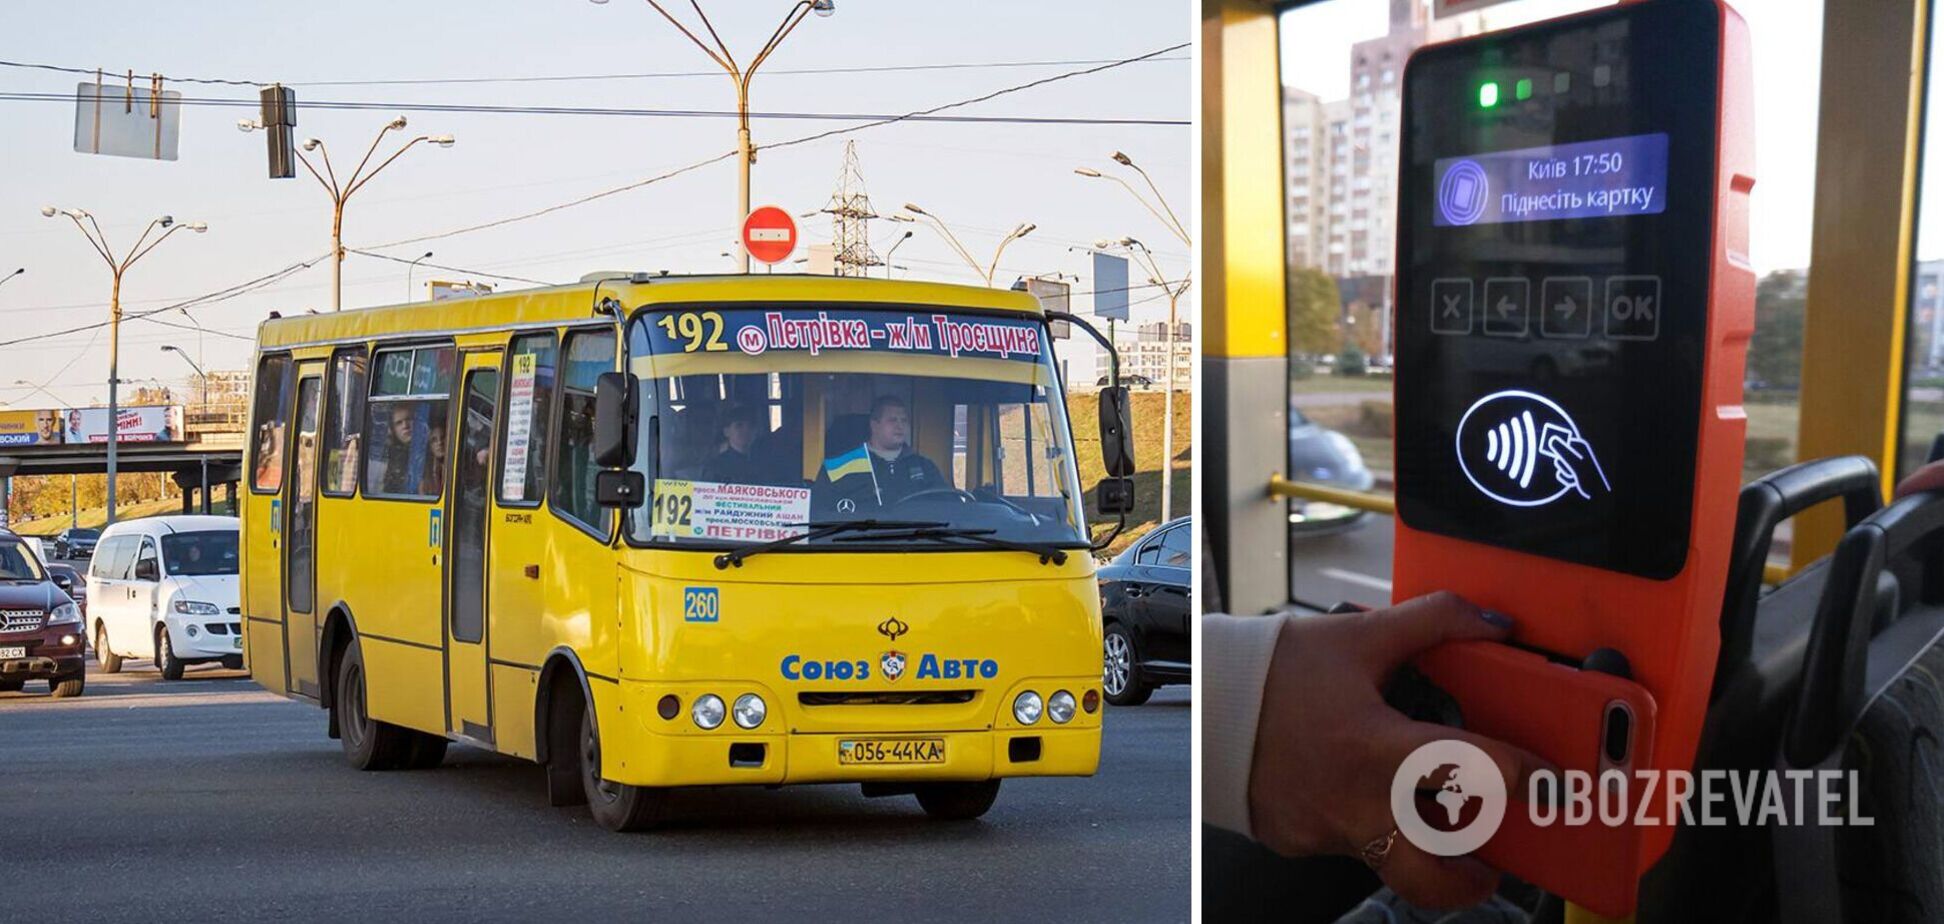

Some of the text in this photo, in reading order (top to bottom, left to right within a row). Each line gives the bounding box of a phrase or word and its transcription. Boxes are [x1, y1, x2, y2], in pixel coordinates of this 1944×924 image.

[1528, 152, 1622, 180] Київ 17:50
[1501, 186, 1654, 216] Піднесіть картку
[1611, 295, 1654, 321] OK
[657, 311, 729, 353] 192
[765, 312, 871, 356] Петрівка
[885, 316, 932, 349] ж/м
[932, 314, 1041, 358] Троєщина
[654, 493, 692, 526] 192
[686, 592, 718, 618] 260
[780, 654, 870, 680] Союз
[916, 653, 999, 680] Авто
